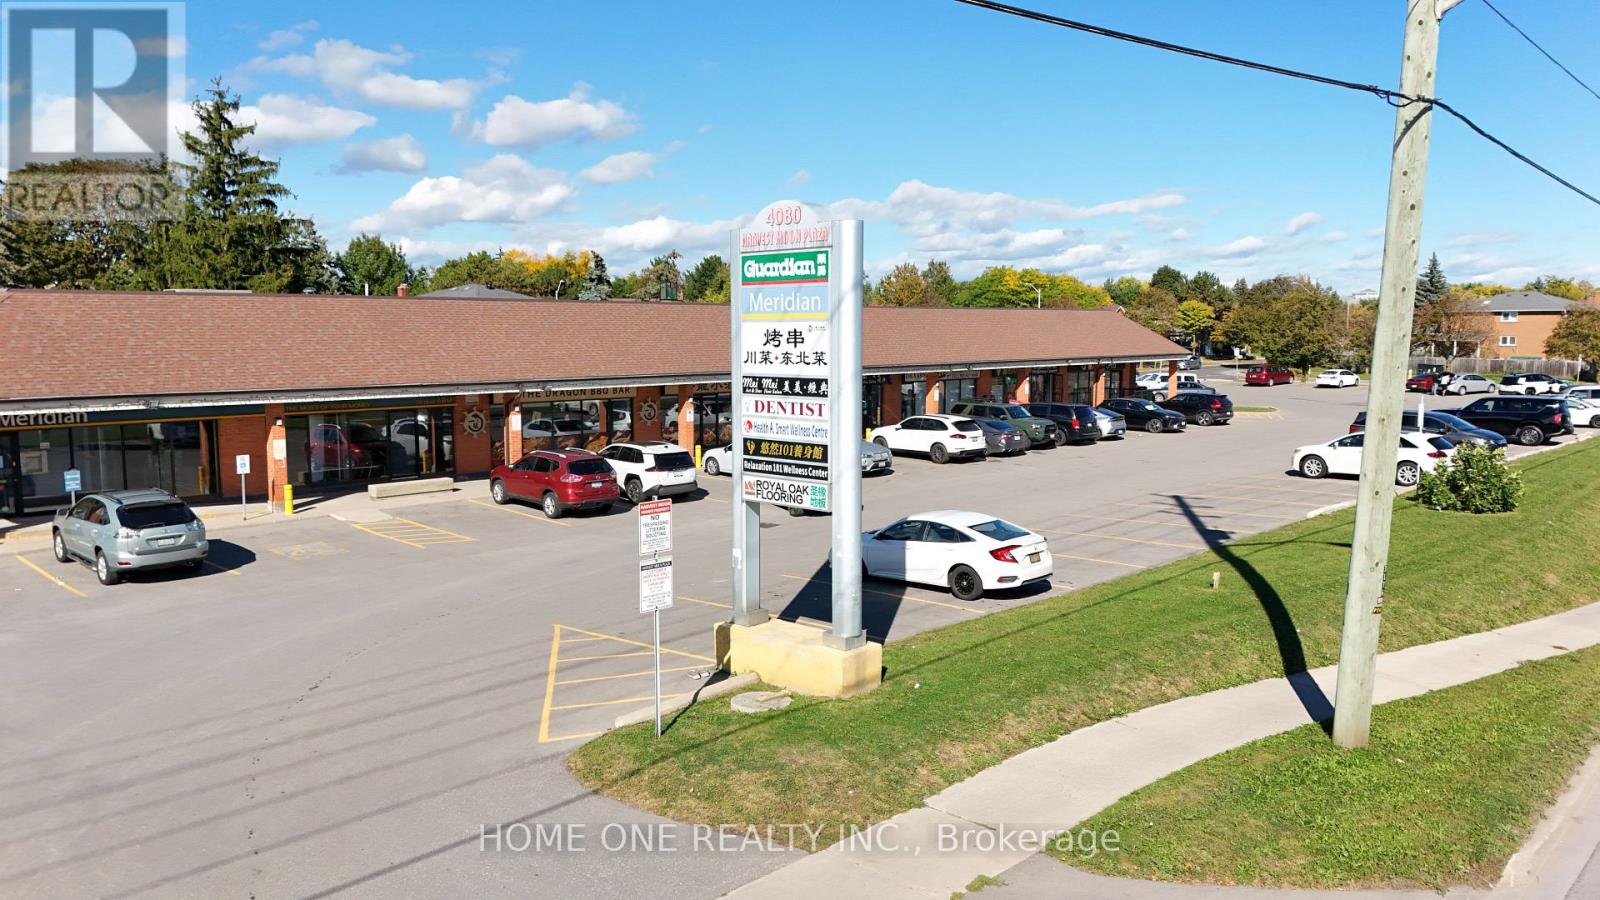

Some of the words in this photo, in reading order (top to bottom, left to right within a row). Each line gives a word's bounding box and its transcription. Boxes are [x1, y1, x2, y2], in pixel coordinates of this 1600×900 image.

[766, 206, 802, 226] 4080
[743, 257, 816, 279] Guardian
[749, 291, 821, 313] Meridian
[763, 328, 805, 348] 烤串
[521, 390, 541, 399] THE
[545, 387, 586, 398] DRAGON
[612, 385, 631, 395] BAR
[743, 377, 759, 388] Mei
[761, 378, 779, 389] Mei
[754, 399, 826, 417] DENTIST
[753, 421, 769, 434] Health
[776, 422, 789, 435] Smart
[790, 423, 811, 438] Wellness
[811, 424, 828, 439] Centre
[743, 460, 773, 472] Relaxation
[773, 463, 783, 473] 101
[783, 464, 808, 476] Wellness
[808, 467, 828, 478] Center
[756, 479, 787, 493] ROYAL
[788, 483, 809, 496] OAK
[756, 489, 804, 505] FLOORING
